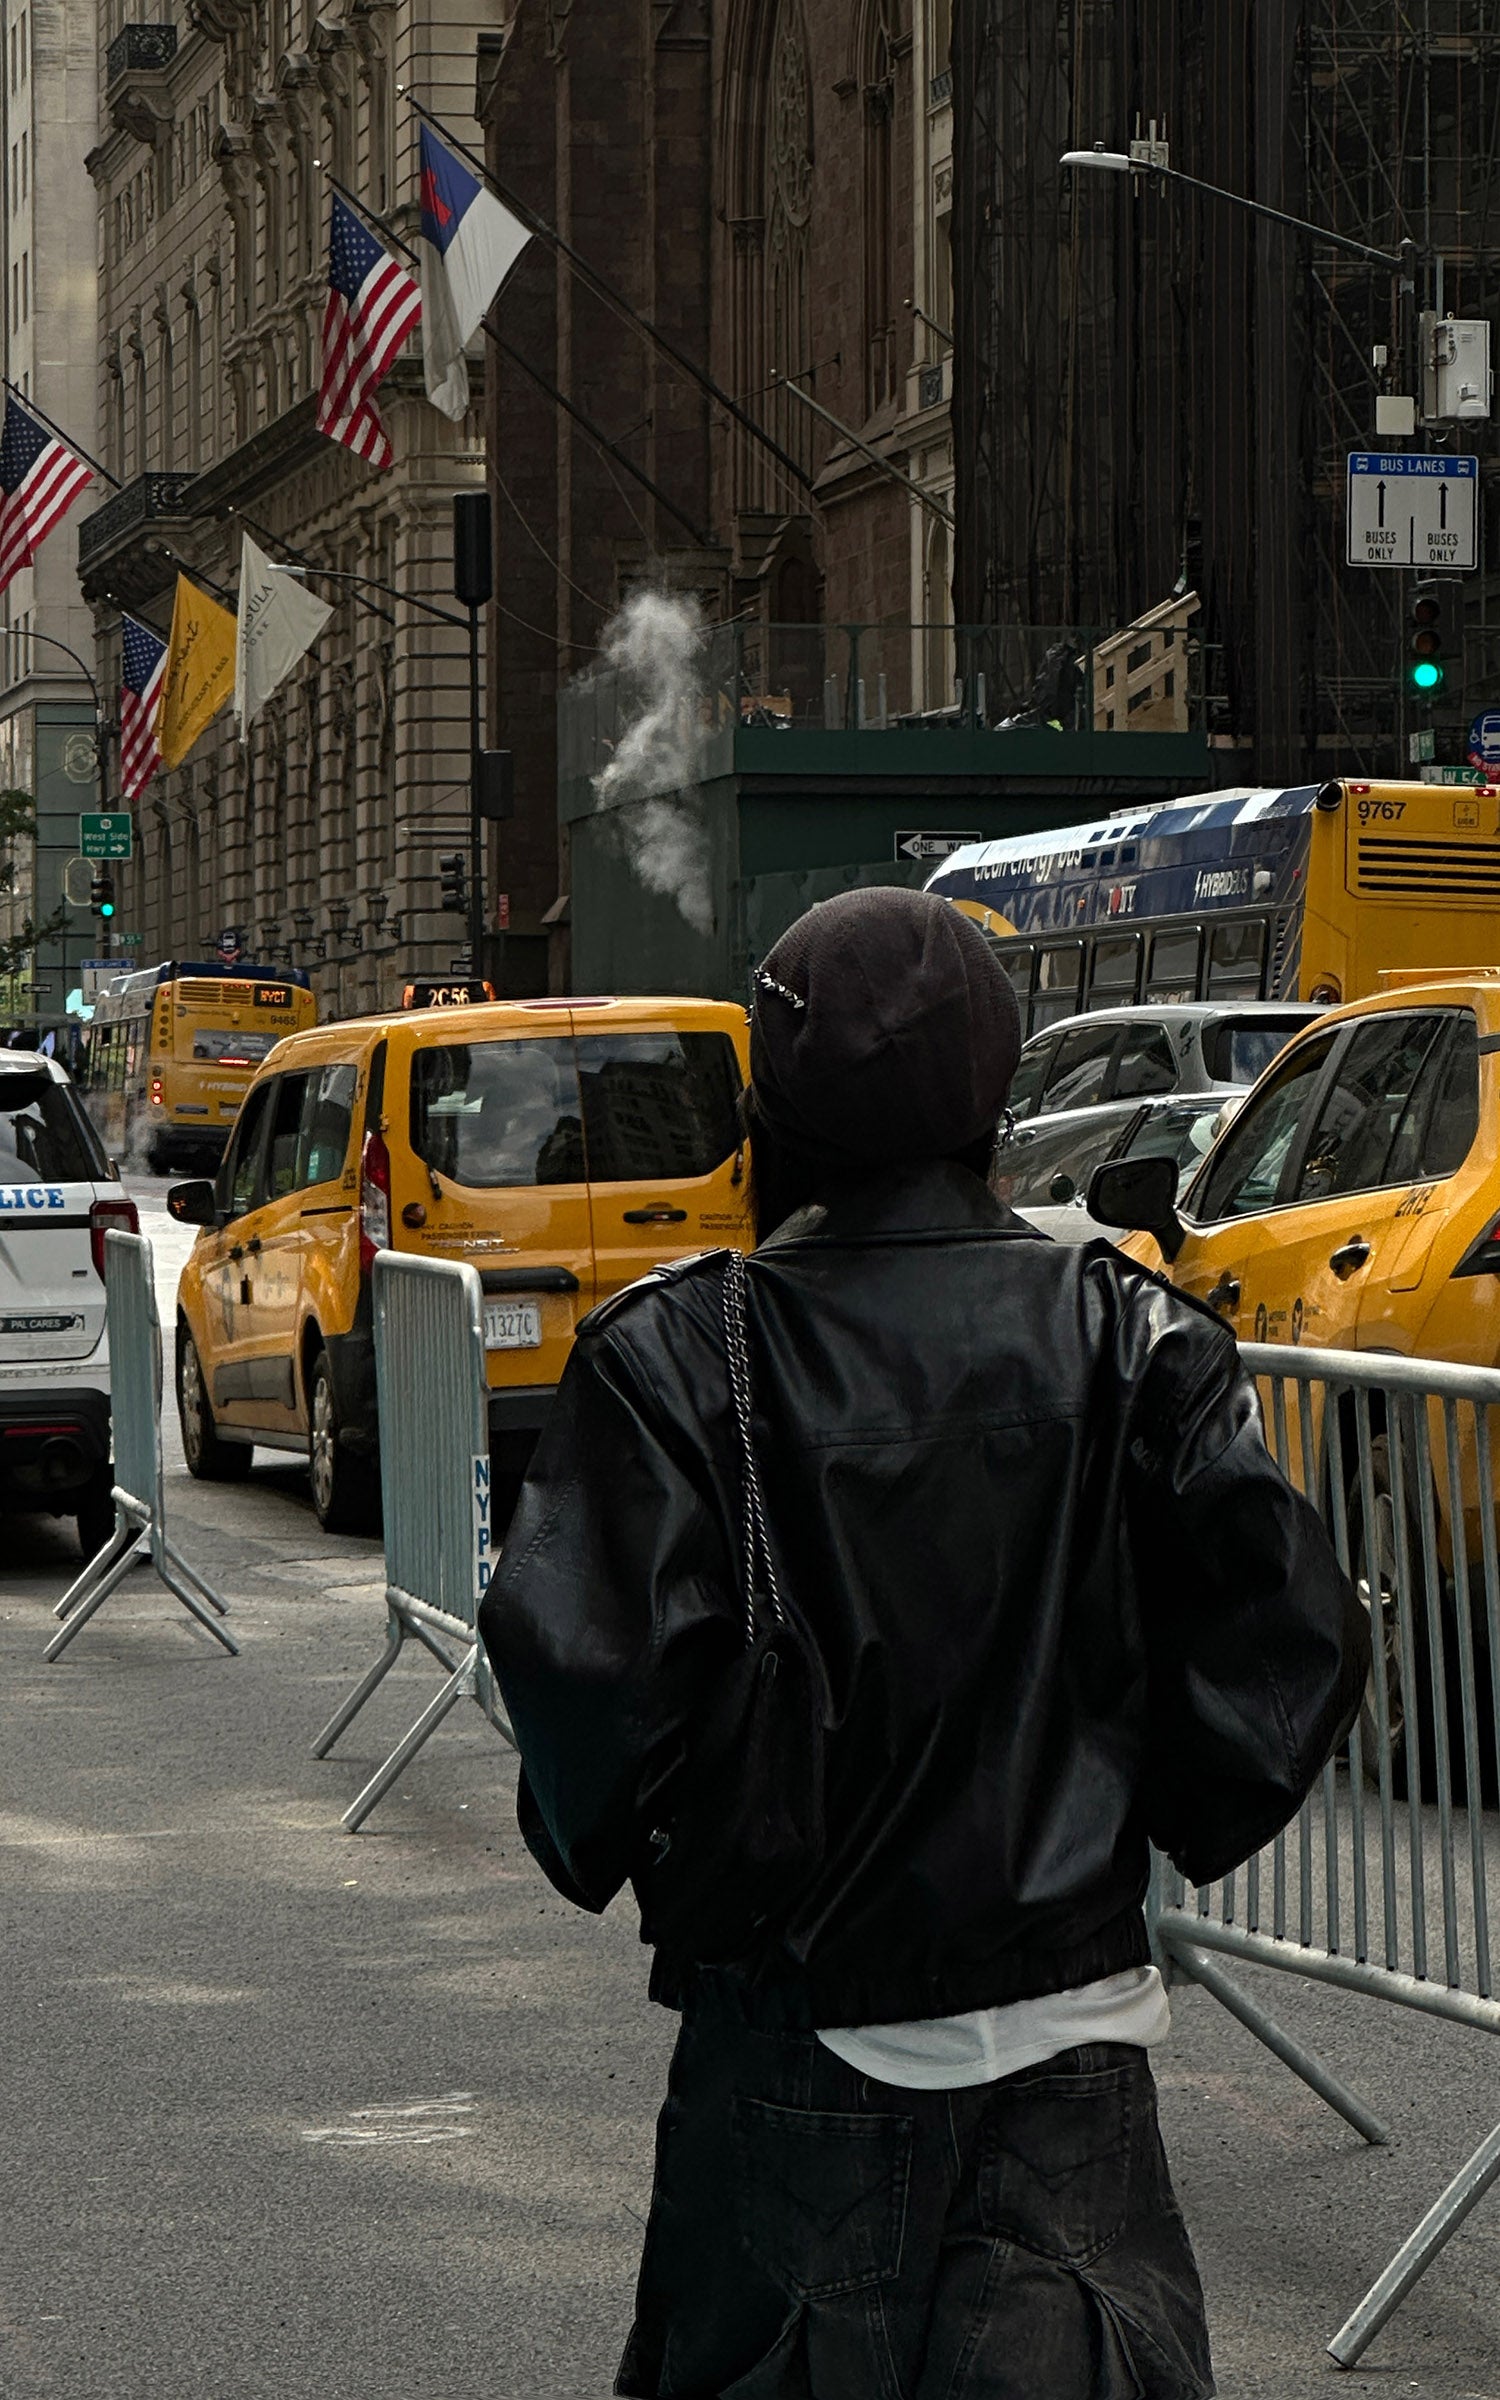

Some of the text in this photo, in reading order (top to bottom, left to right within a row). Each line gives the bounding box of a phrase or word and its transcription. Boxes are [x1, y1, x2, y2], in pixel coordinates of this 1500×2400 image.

[1380, 459, 1445, 473] BUS LANES
[1365, 531, 1397, 544] BUSES
[1427, 533, 1459, 546] BUSES
[1368, 547, 1394, 560] ONLY
[1429, 549, 1456, 562] ONLY
[1444, 770, 1456, 784] W
[1358, 800, 1407, 820] 9767
[912, 841, 935, 853] ONE
[428, 987, 470, 1007] 2C56
[11, 1319, 61, 1329] PAL CARES
[475, 1459, 491, 1590] NYPD
